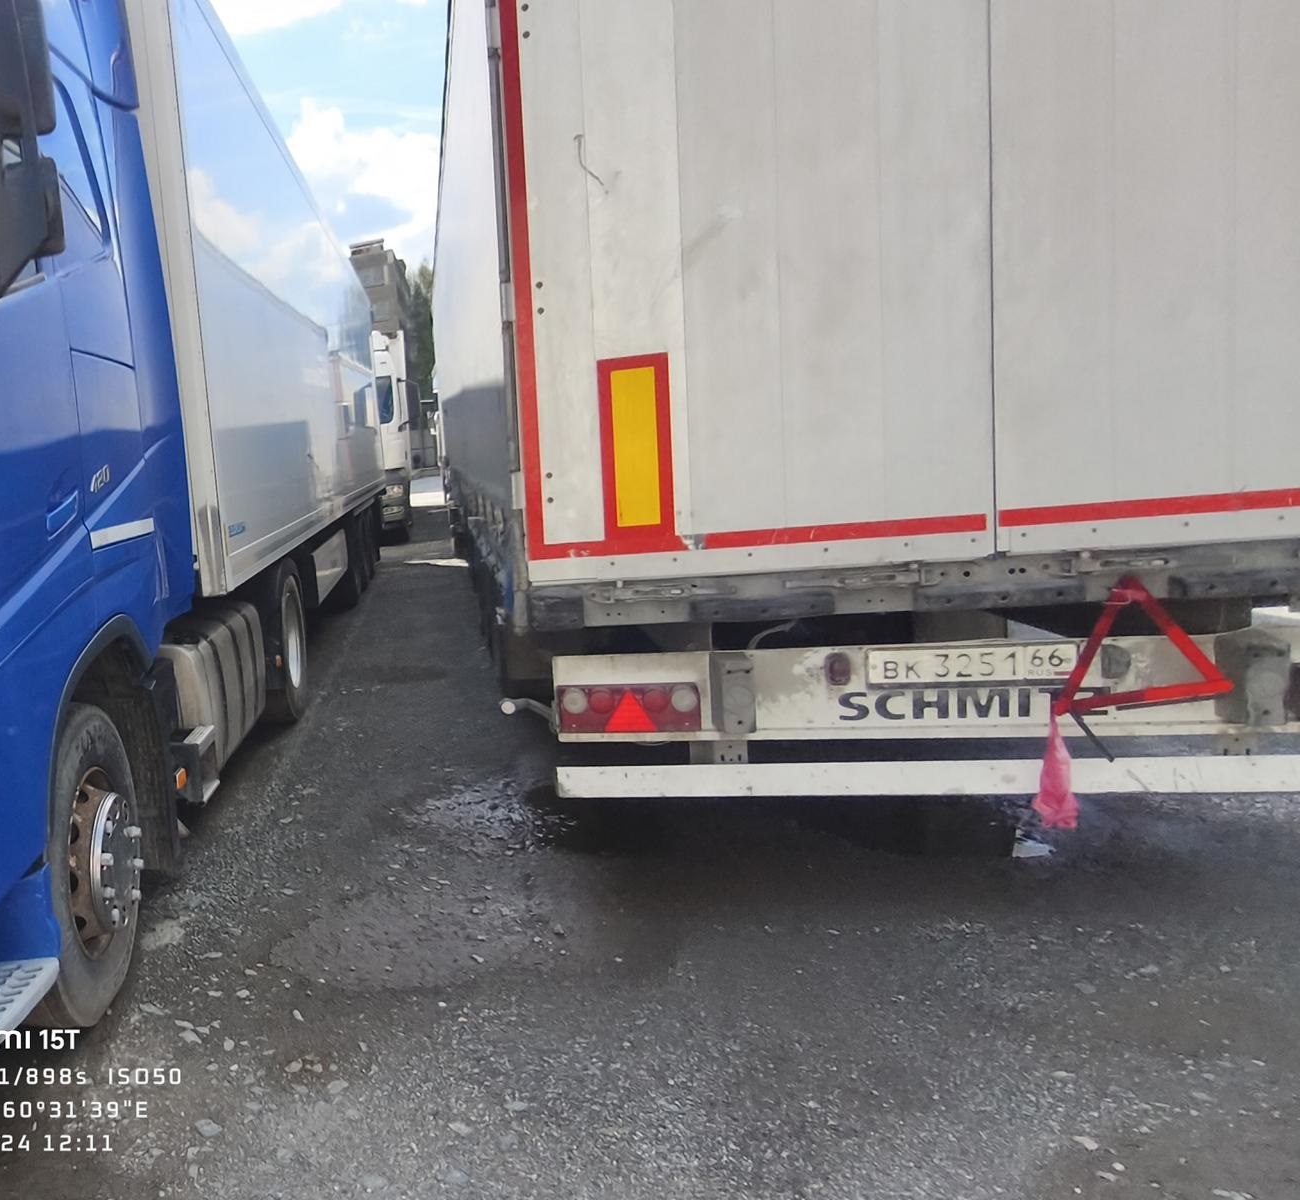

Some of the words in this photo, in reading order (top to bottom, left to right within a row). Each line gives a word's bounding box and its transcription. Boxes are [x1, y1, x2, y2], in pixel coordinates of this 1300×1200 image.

[90, 464, 110, 493] 420
[934, 652, 1018, 678] 3251
[1030, 648, 1064, 667] 66
